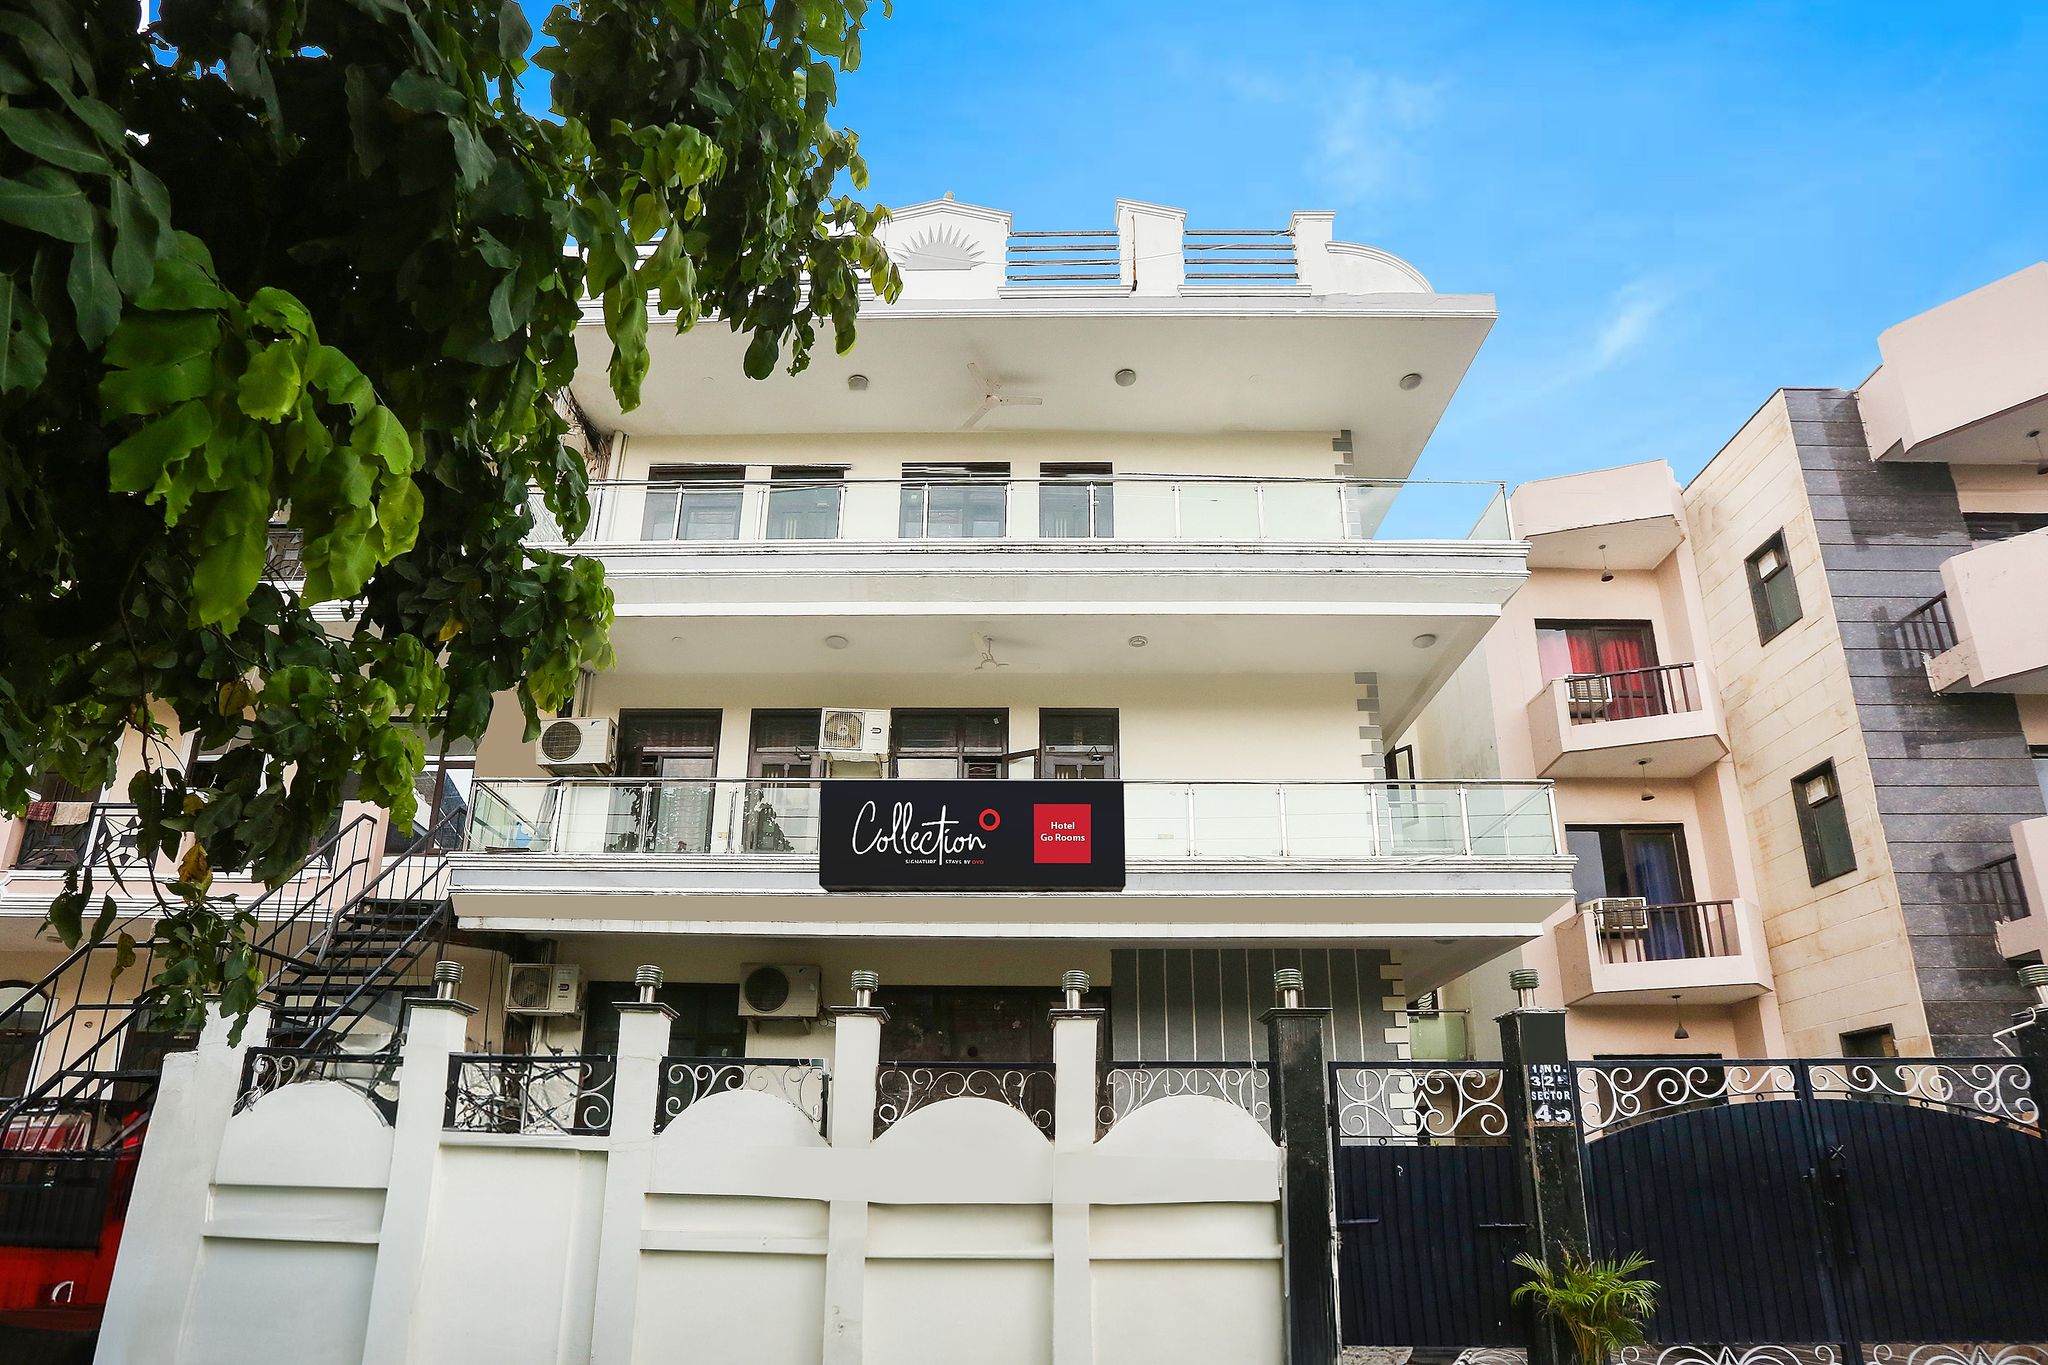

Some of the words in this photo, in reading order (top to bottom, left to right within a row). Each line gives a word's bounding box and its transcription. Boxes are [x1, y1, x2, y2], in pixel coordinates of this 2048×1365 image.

[1051, 821, 1075, 830] Hotel
[852, 800, 986, 865] Collection
[1040, 832, 1053, 842] Go
[1055, 832, 1086, 842] Rooms
[1531, 1091, 1571, 1101] SECTOR
[1534, 1104, 1571, 1123] 45
